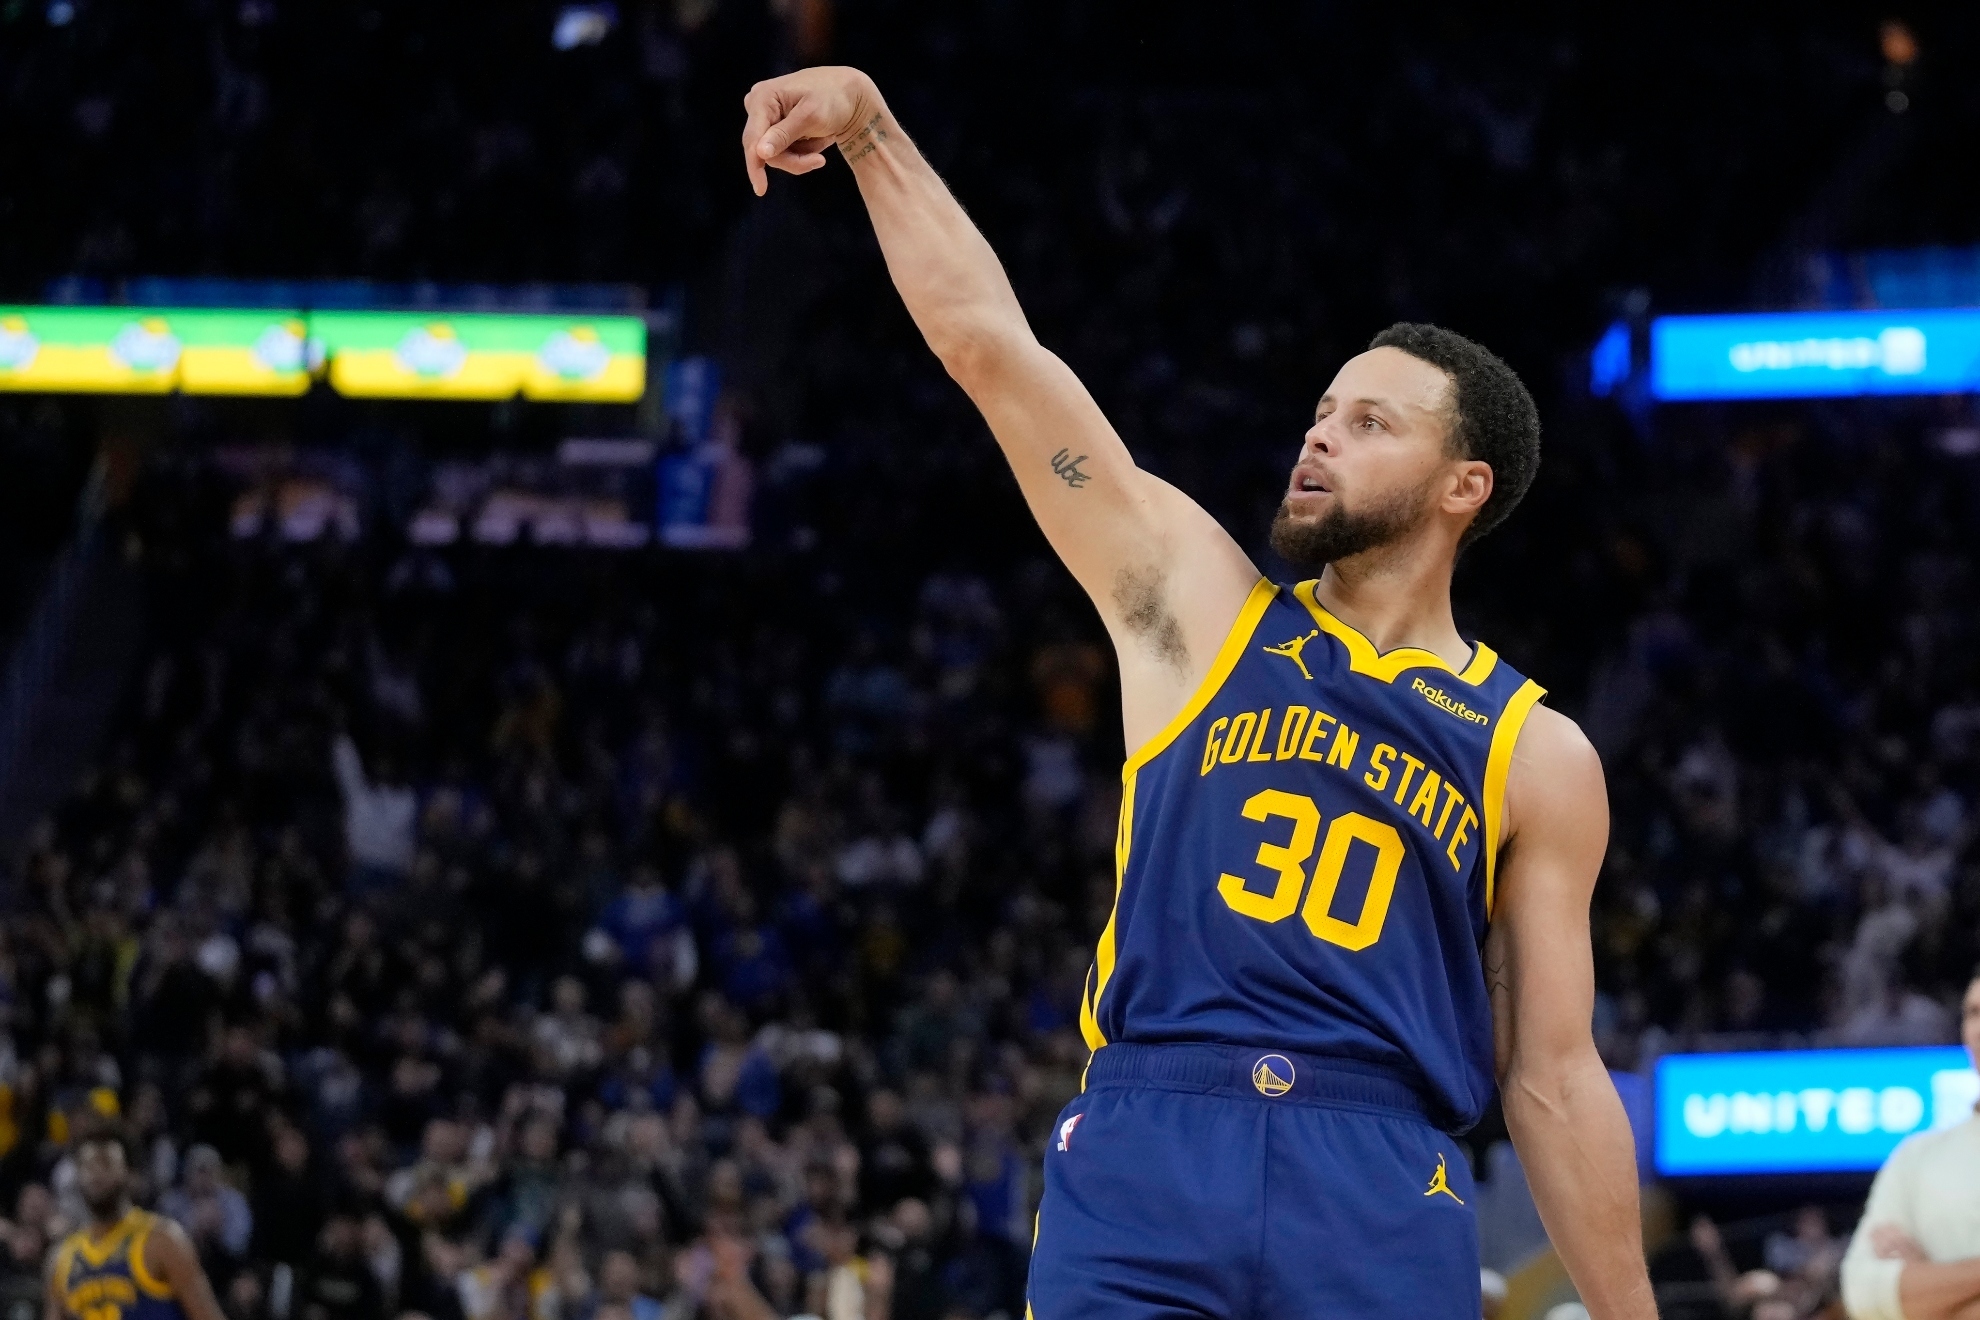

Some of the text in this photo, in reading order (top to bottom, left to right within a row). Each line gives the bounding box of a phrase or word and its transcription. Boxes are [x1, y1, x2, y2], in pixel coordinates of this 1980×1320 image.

[1411, 677, 1489, 726] Rakuten
[1200, 705, 1480, 873] GOLDEN STATE
[1217, 788, 1406, 952] 30
